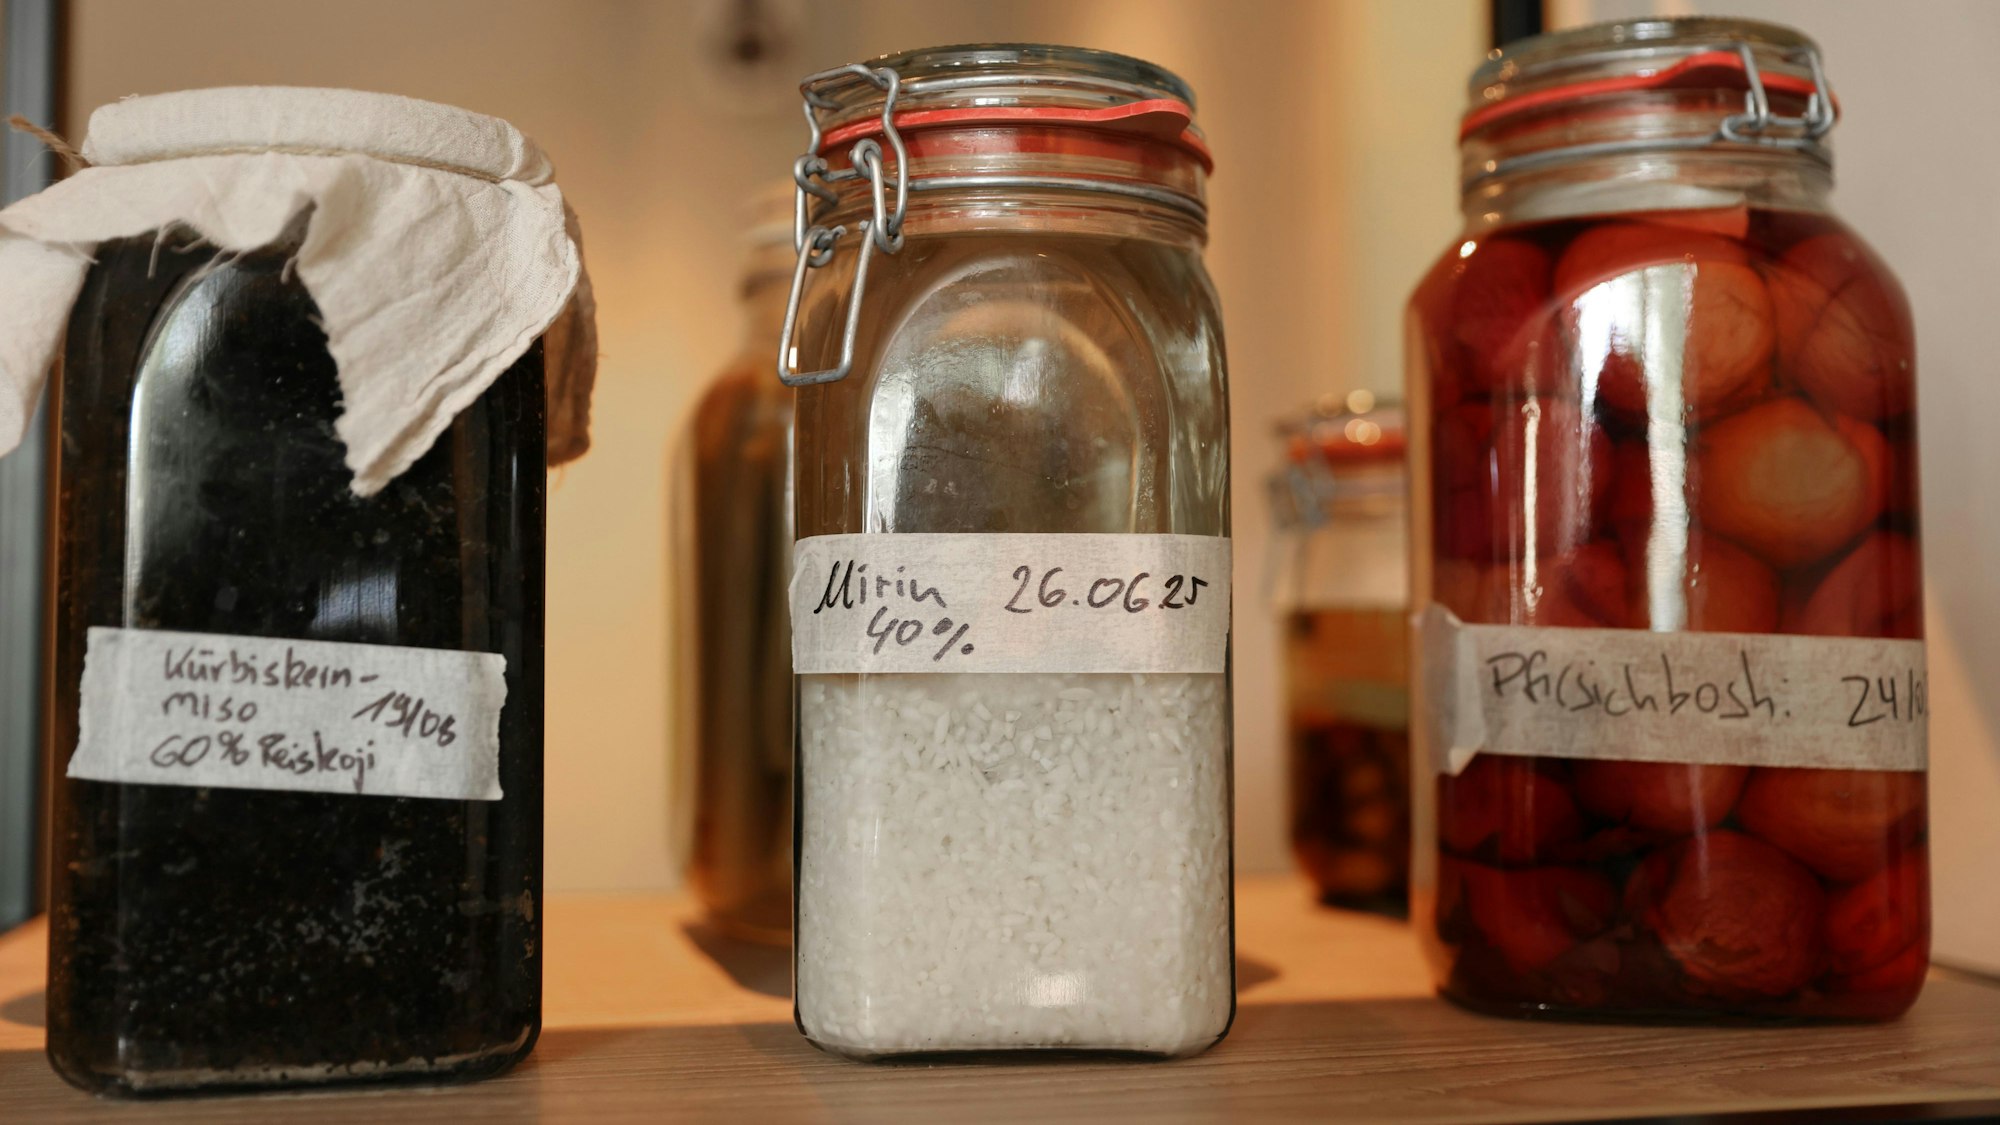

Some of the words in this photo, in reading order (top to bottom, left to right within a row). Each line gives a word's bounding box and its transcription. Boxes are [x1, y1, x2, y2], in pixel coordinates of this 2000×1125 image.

[813, 559, 949, 615] Mirin
[865, 606, 976, 662] 40%
[257, 730, 378, 794] Reiskoji
